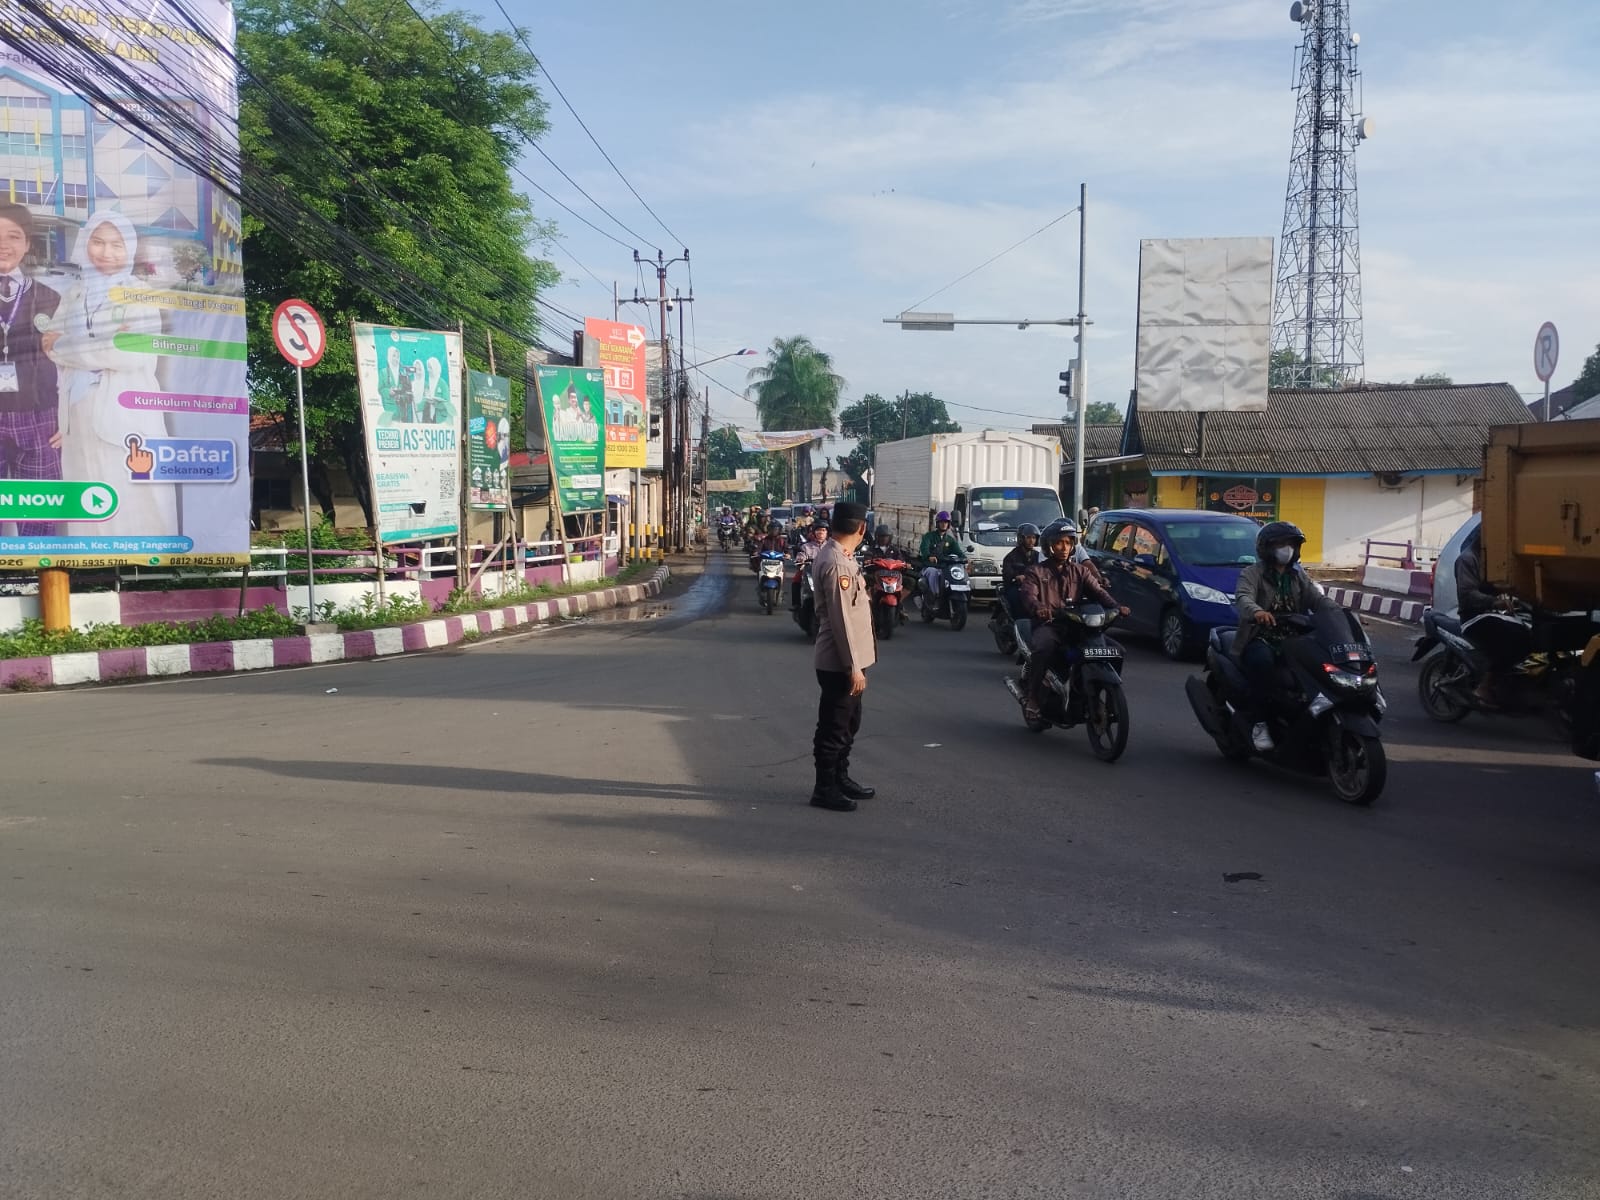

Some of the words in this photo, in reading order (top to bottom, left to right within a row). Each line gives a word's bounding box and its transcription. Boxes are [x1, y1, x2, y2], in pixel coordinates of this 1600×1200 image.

[152, 338, 201, 353] Bilingual
[134, 396, 192, 408] Kurikulum
[193, 399, 238, 411] Nasional
[159, 446, 230, 463] Daftar
[160, 465, 213, 476] Sekarang
[19, 494, 64, 506] NOW
[1, 542, 25, 551] Desa
[28, 542, 88, 552] Sukamanah,
[91, 542, 110, 551] Kec.
[113, 542, 138, 552] Rajeg
[141, 542, 188, 552] Tangerang
